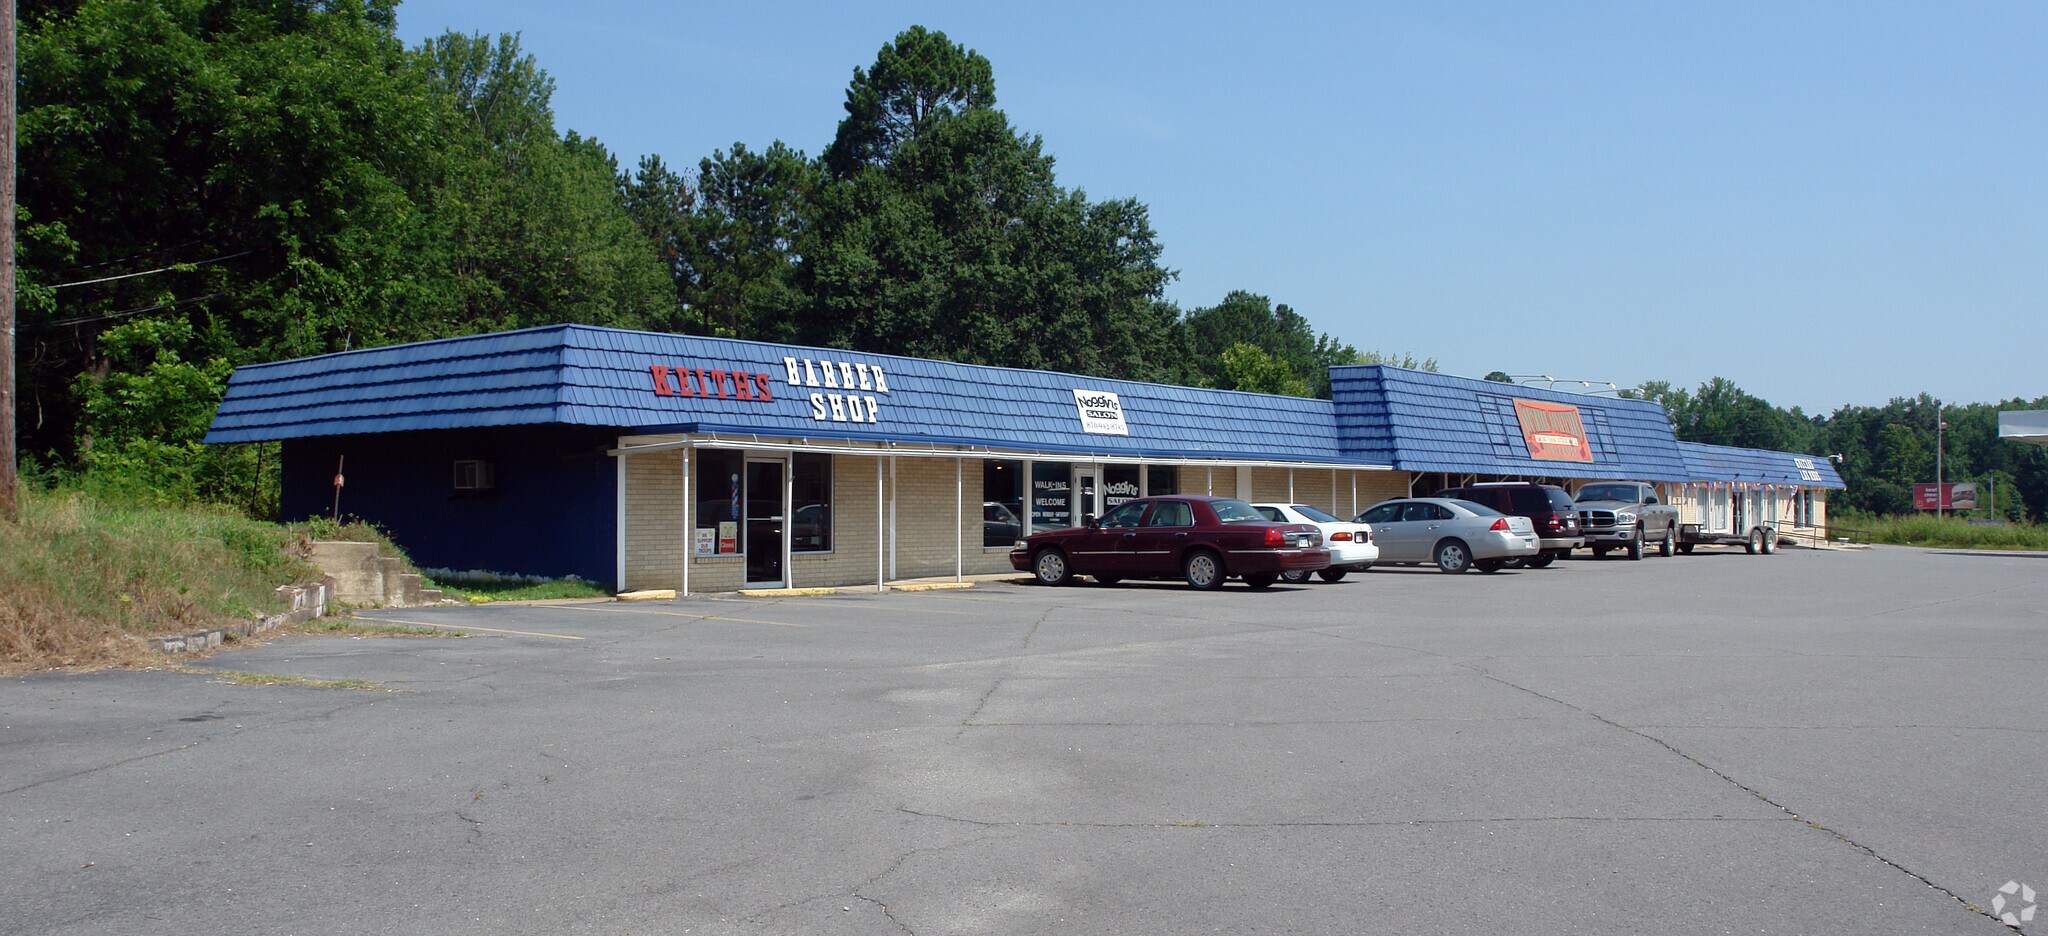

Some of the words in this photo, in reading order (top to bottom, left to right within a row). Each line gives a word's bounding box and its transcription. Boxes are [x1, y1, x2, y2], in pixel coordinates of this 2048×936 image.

[783, 356, 889, 393] BARBER
[649, 364, 773, 402] KEITHS
[810, 393, 879, 423] SHOP
[1077, 395, 1119, 411] Noggins
[1087, 411, 1118, 419] SALON
[1103, 480, 1139, 496] Noggins
[1035, 498, 1066, 506] WELCOME
